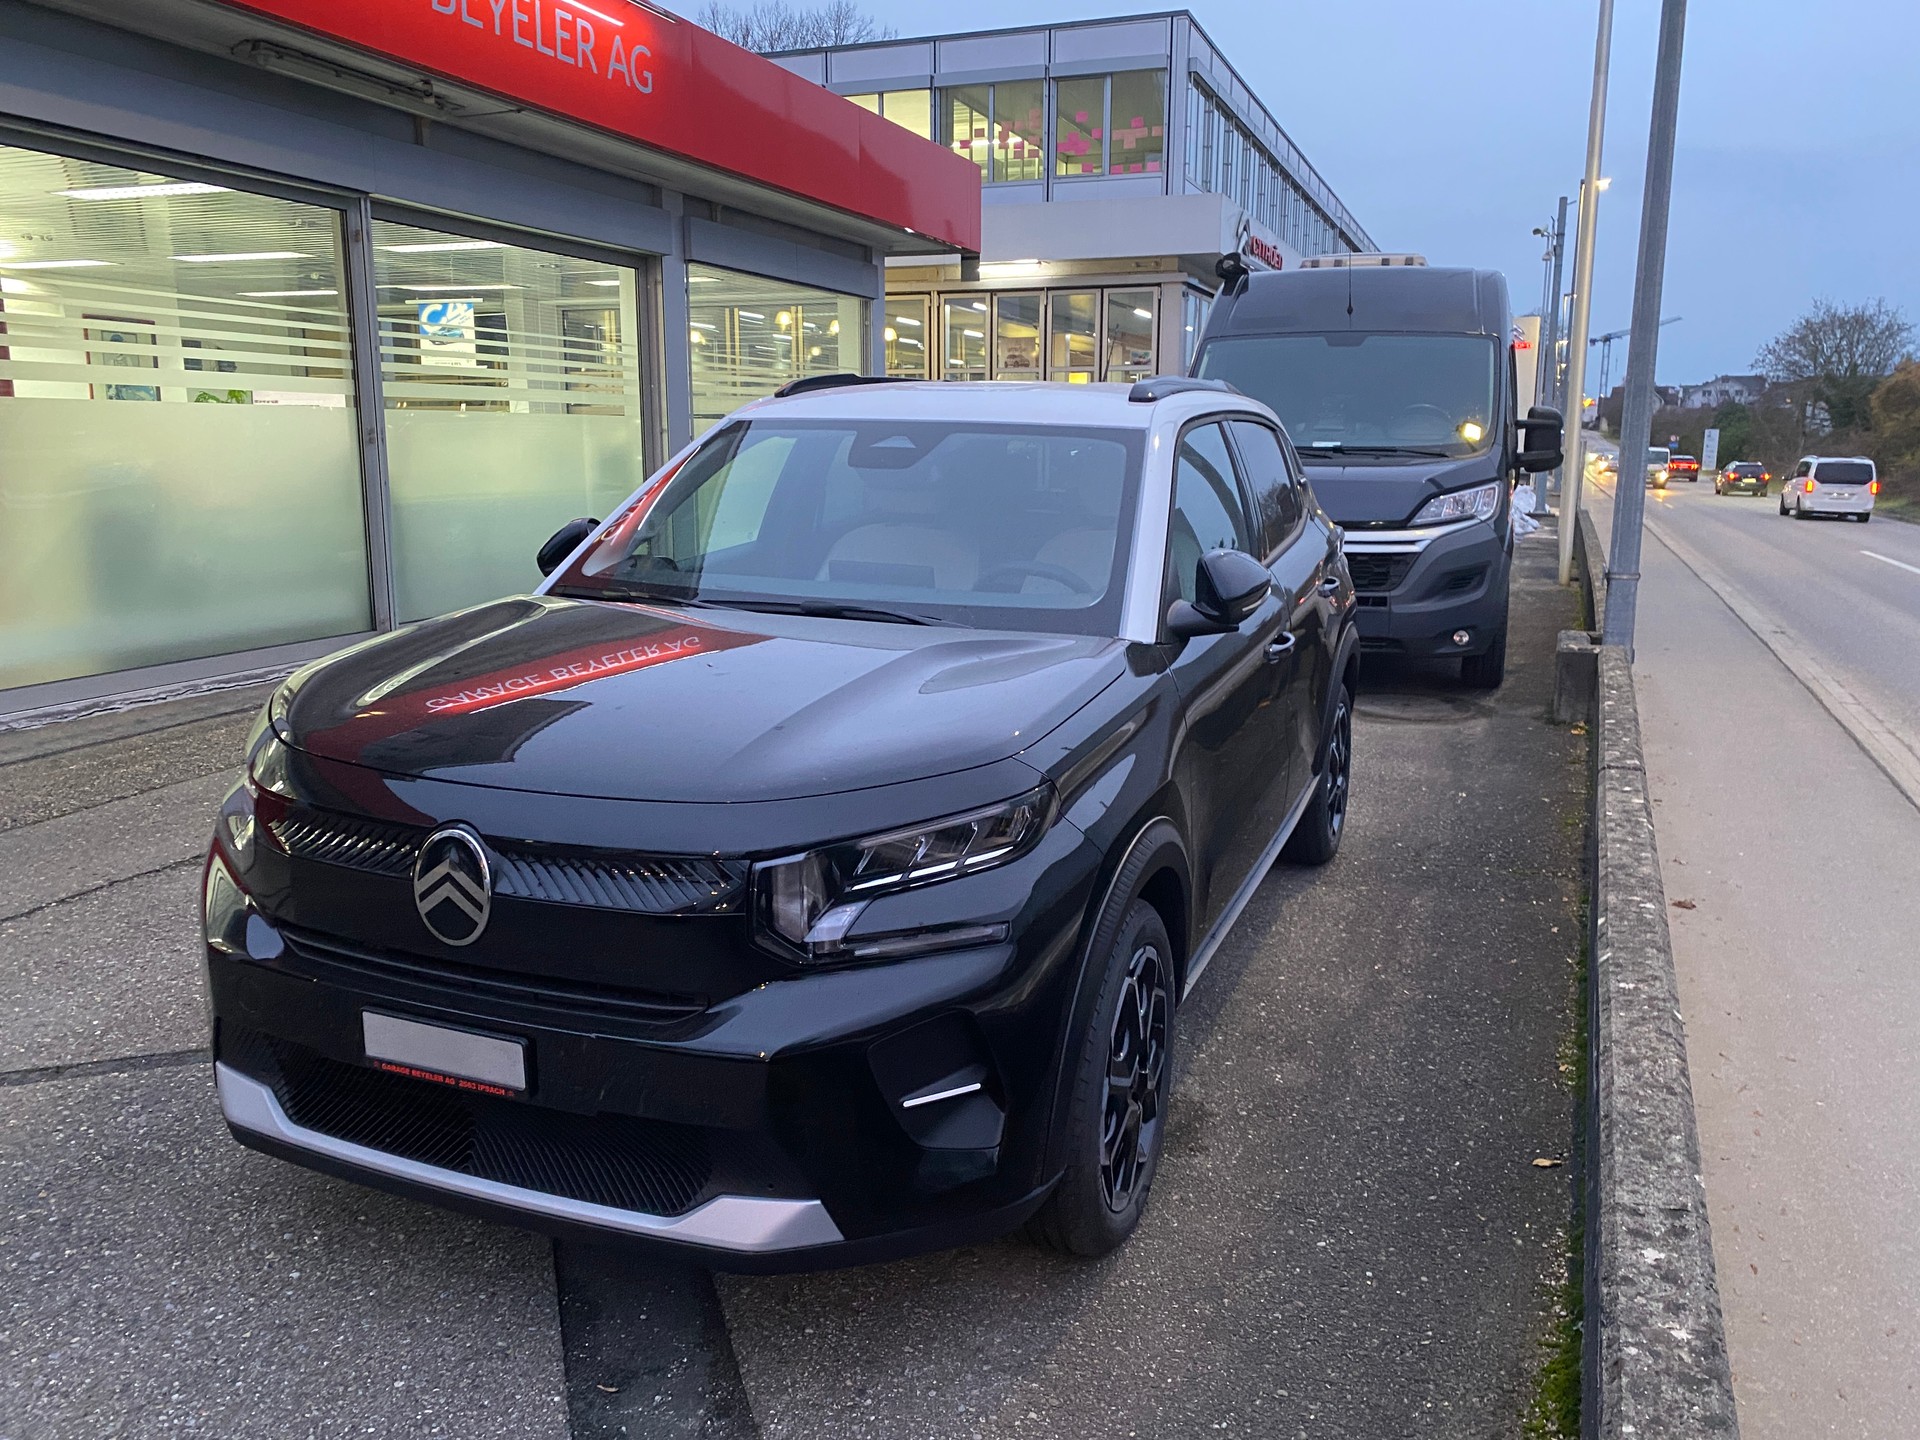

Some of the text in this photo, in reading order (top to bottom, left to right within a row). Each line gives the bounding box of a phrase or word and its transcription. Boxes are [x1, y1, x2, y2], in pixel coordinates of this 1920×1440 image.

[431, 0, 653, 94] YELER AG
[381, 1063, 410, 1075] GARAGE
[445, 1077, 456, 1085] AG
